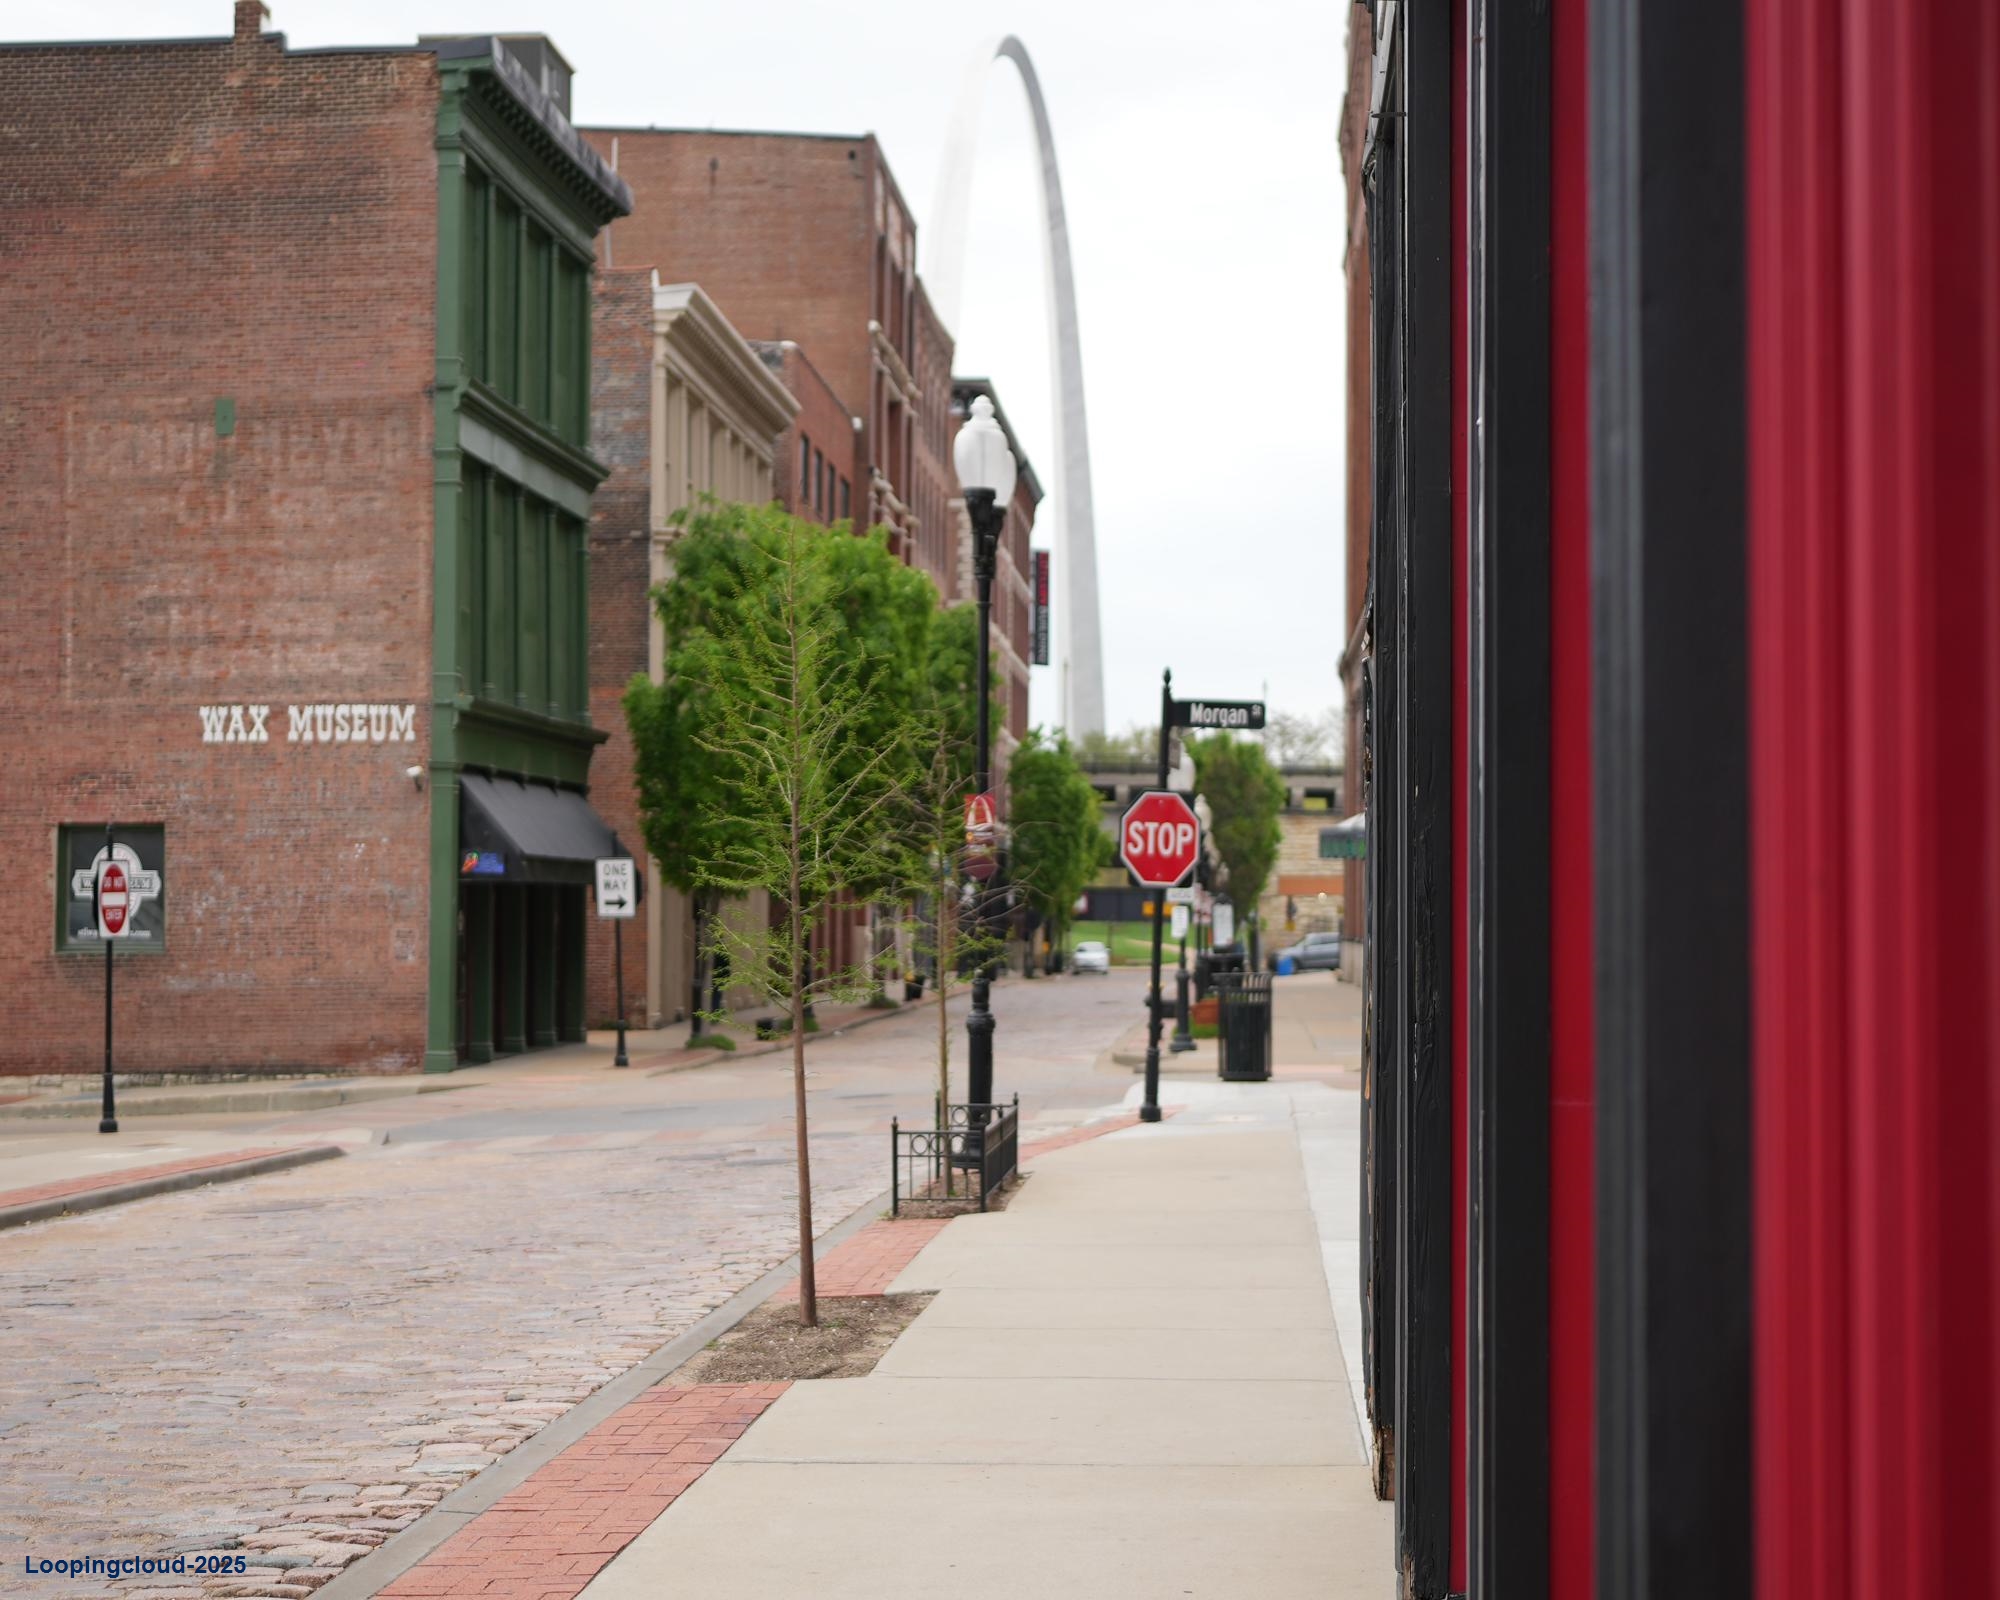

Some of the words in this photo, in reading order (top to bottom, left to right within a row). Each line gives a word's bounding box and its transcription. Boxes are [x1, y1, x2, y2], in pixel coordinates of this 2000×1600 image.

[199, 704, 270, 743] WAX
[287, 704, 416, 743] MUSEUM
[1190, 702, 1249, 728] Morgan
[1127, 820, 1194, 857] STOP
[603, 863, 627, 876] ONE
[603, 879, 628, 890] WAY
